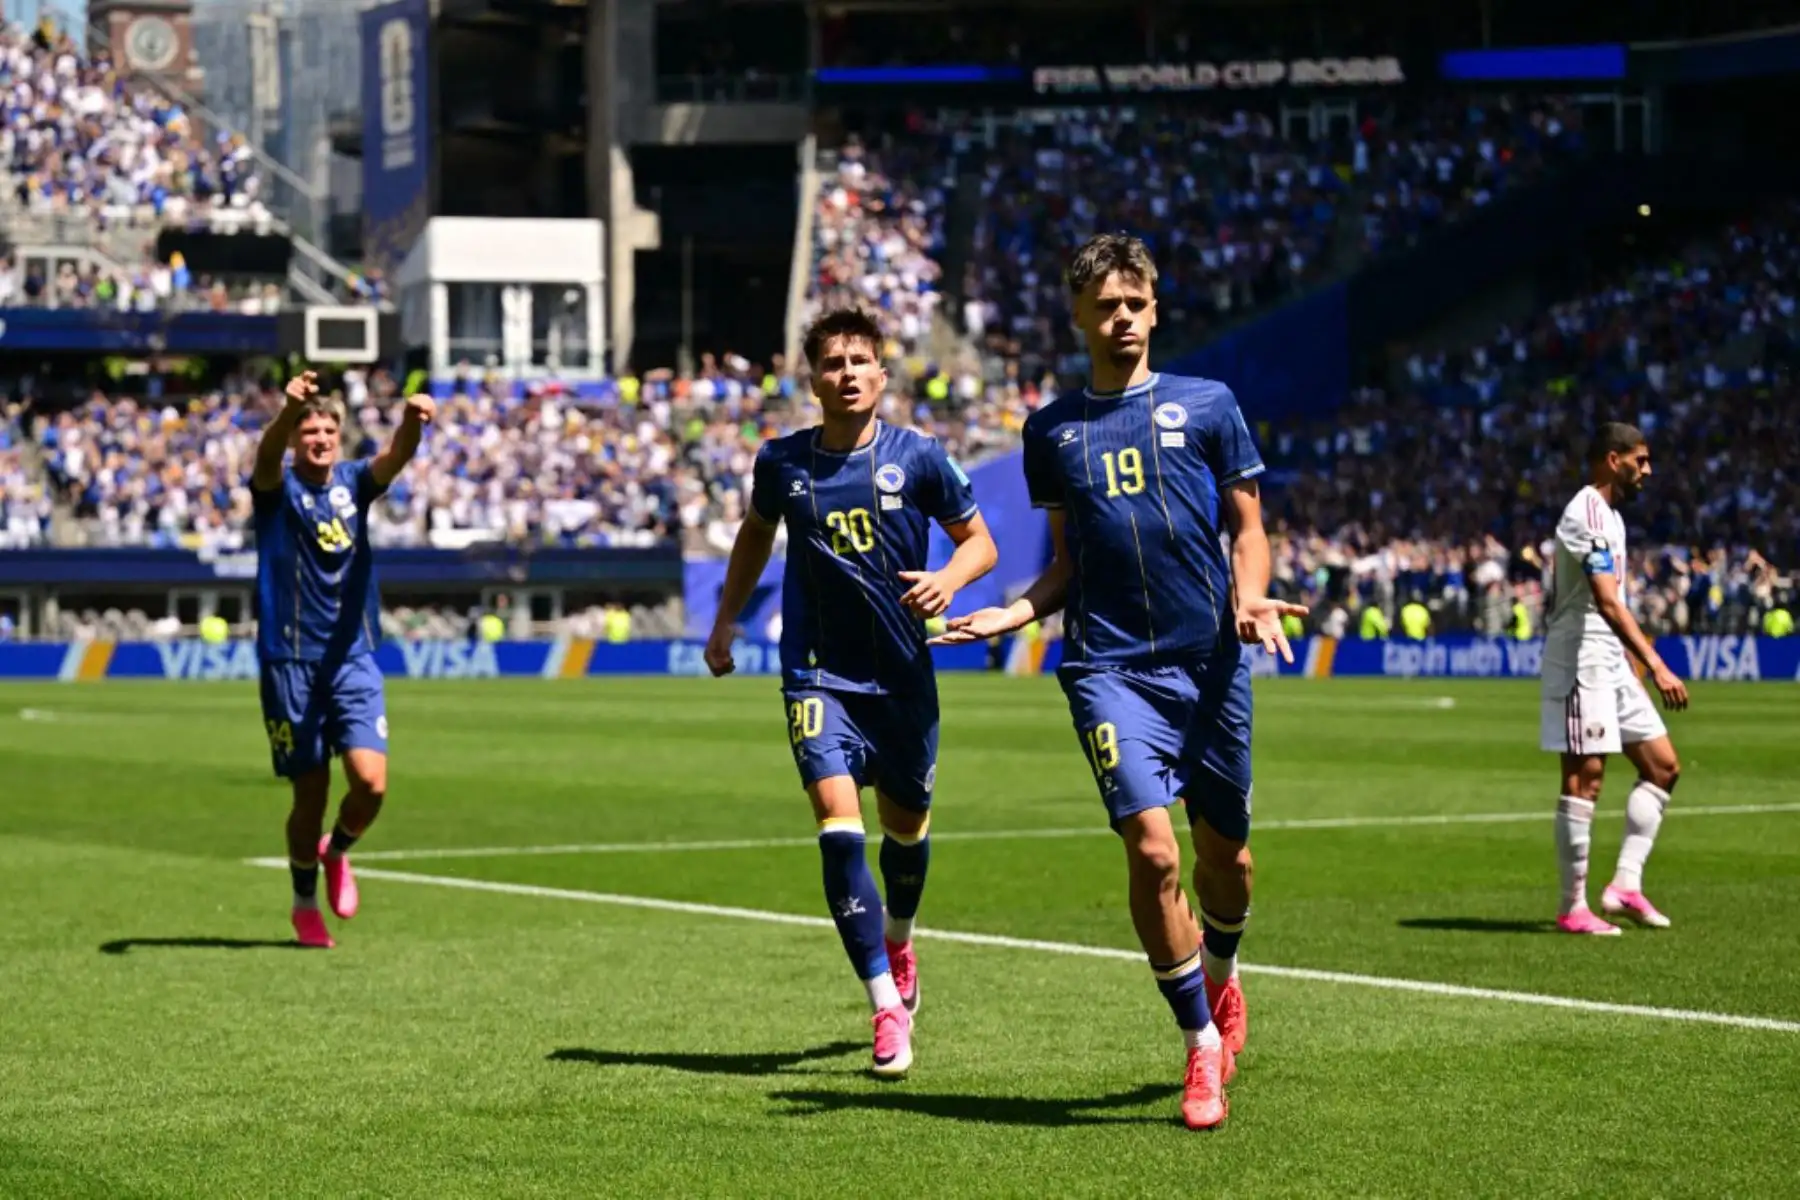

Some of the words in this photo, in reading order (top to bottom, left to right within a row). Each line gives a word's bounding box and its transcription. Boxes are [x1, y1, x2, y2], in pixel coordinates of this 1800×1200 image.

[1104, 63, 1219, 92] WORLD
[1223, 62, 1284, 88] CUP
[1102, 446, 1146, 498] 19
[826, 507, 874, 556] 20
[157, 639, 260, 679] VISA
[394, 637, 500, 679] VISA
[1383, 640, 1424, 680] tap
[1423, 636, 1448, 676] in
[1450, 637, 1503, 677] with
[1681, 633, 1760, 681] VISA
[790, 697, 825, 744] 20
[1087, 722, 1121, 776] 19
